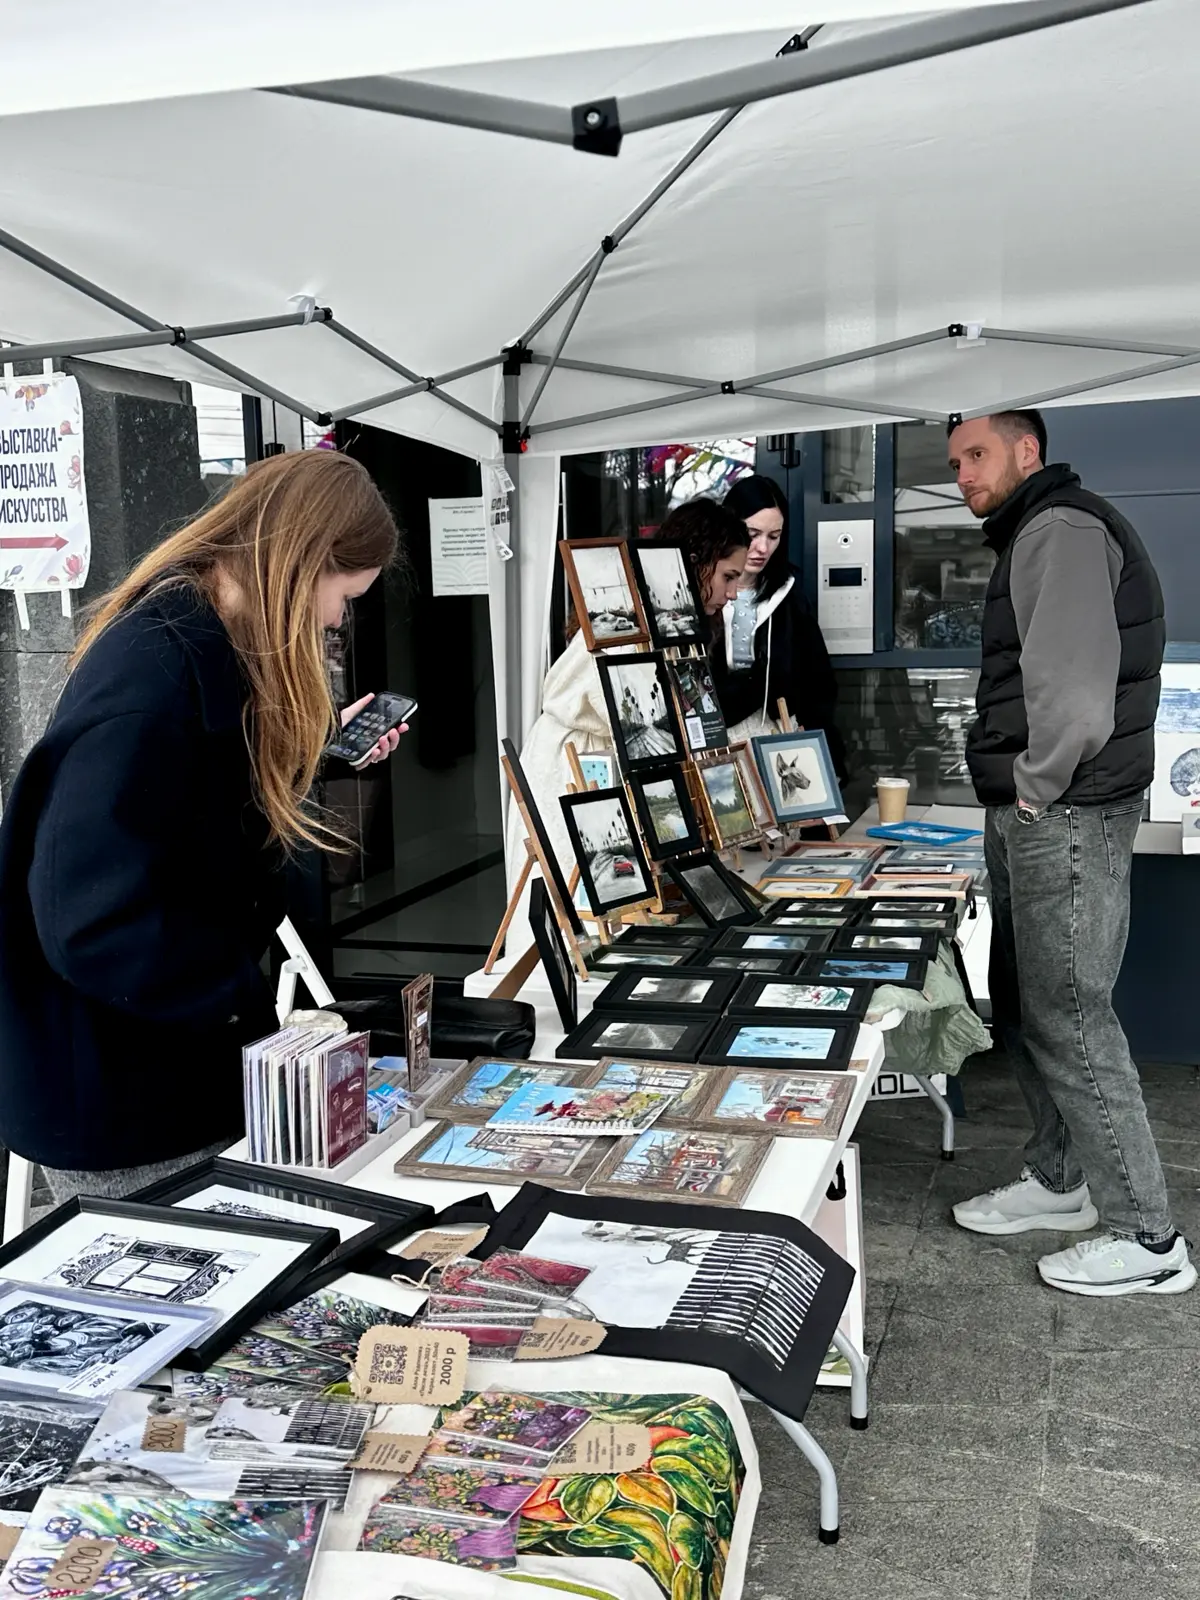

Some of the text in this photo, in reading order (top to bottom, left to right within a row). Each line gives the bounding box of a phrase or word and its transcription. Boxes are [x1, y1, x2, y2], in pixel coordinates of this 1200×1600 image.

[0, 427, 62, 454] ЫСТАВКА-
[0, 497, 68, 523] ИСКУССТВА
[440, 1357, 454, 1386] 2000
[147, 1421, 178, 1449] 2000
[56, 1546, 102, 1585] 2000
